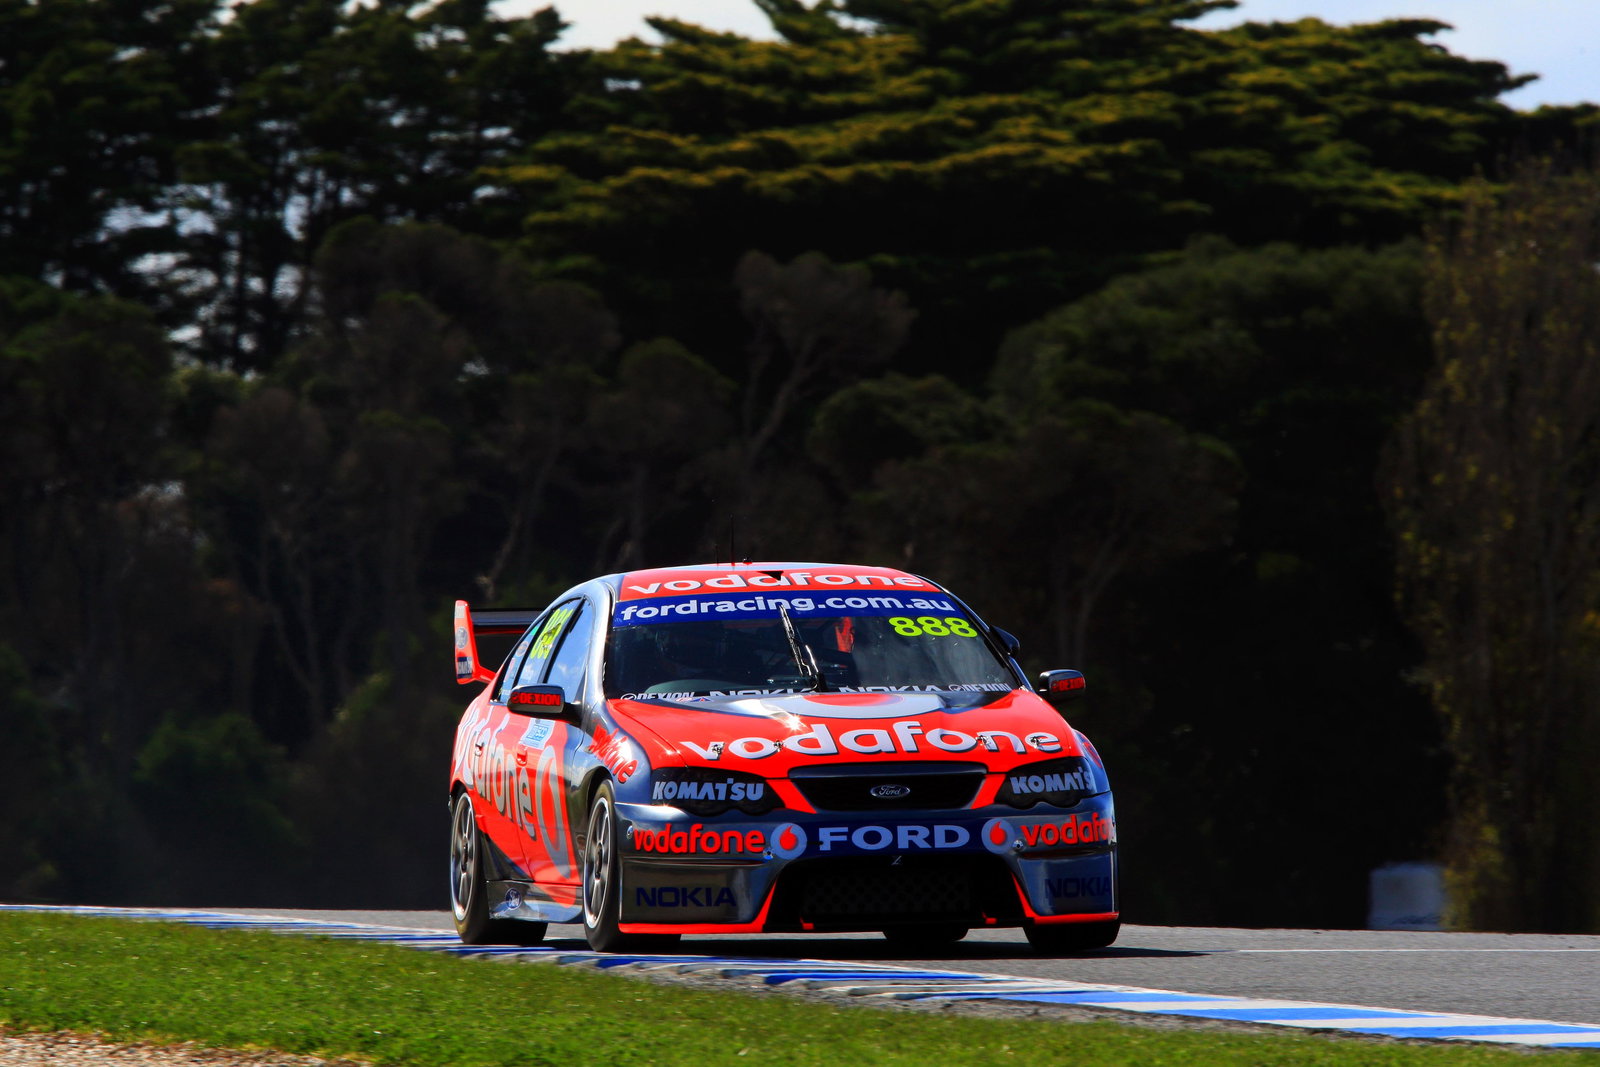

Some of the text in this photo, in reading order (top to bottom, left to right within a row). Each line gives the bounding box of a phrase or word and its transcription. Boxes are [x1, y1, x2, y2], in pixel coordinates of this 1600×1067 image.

[627, 571, 924, 595] vodafone
[621, 596, 956, 621] fordracing.com.au
[889, 616, 978, 638] 888
[519, 691, 561, 706] DEXION
[680, 720, 1063, 760] vodafone
[633, 823, 767, 854] vodafone
[818, 824, 971, 851] FORD
[635, 886, 738, 909] NOKIA
[1044, 877, 1111, 899] NOKIA
